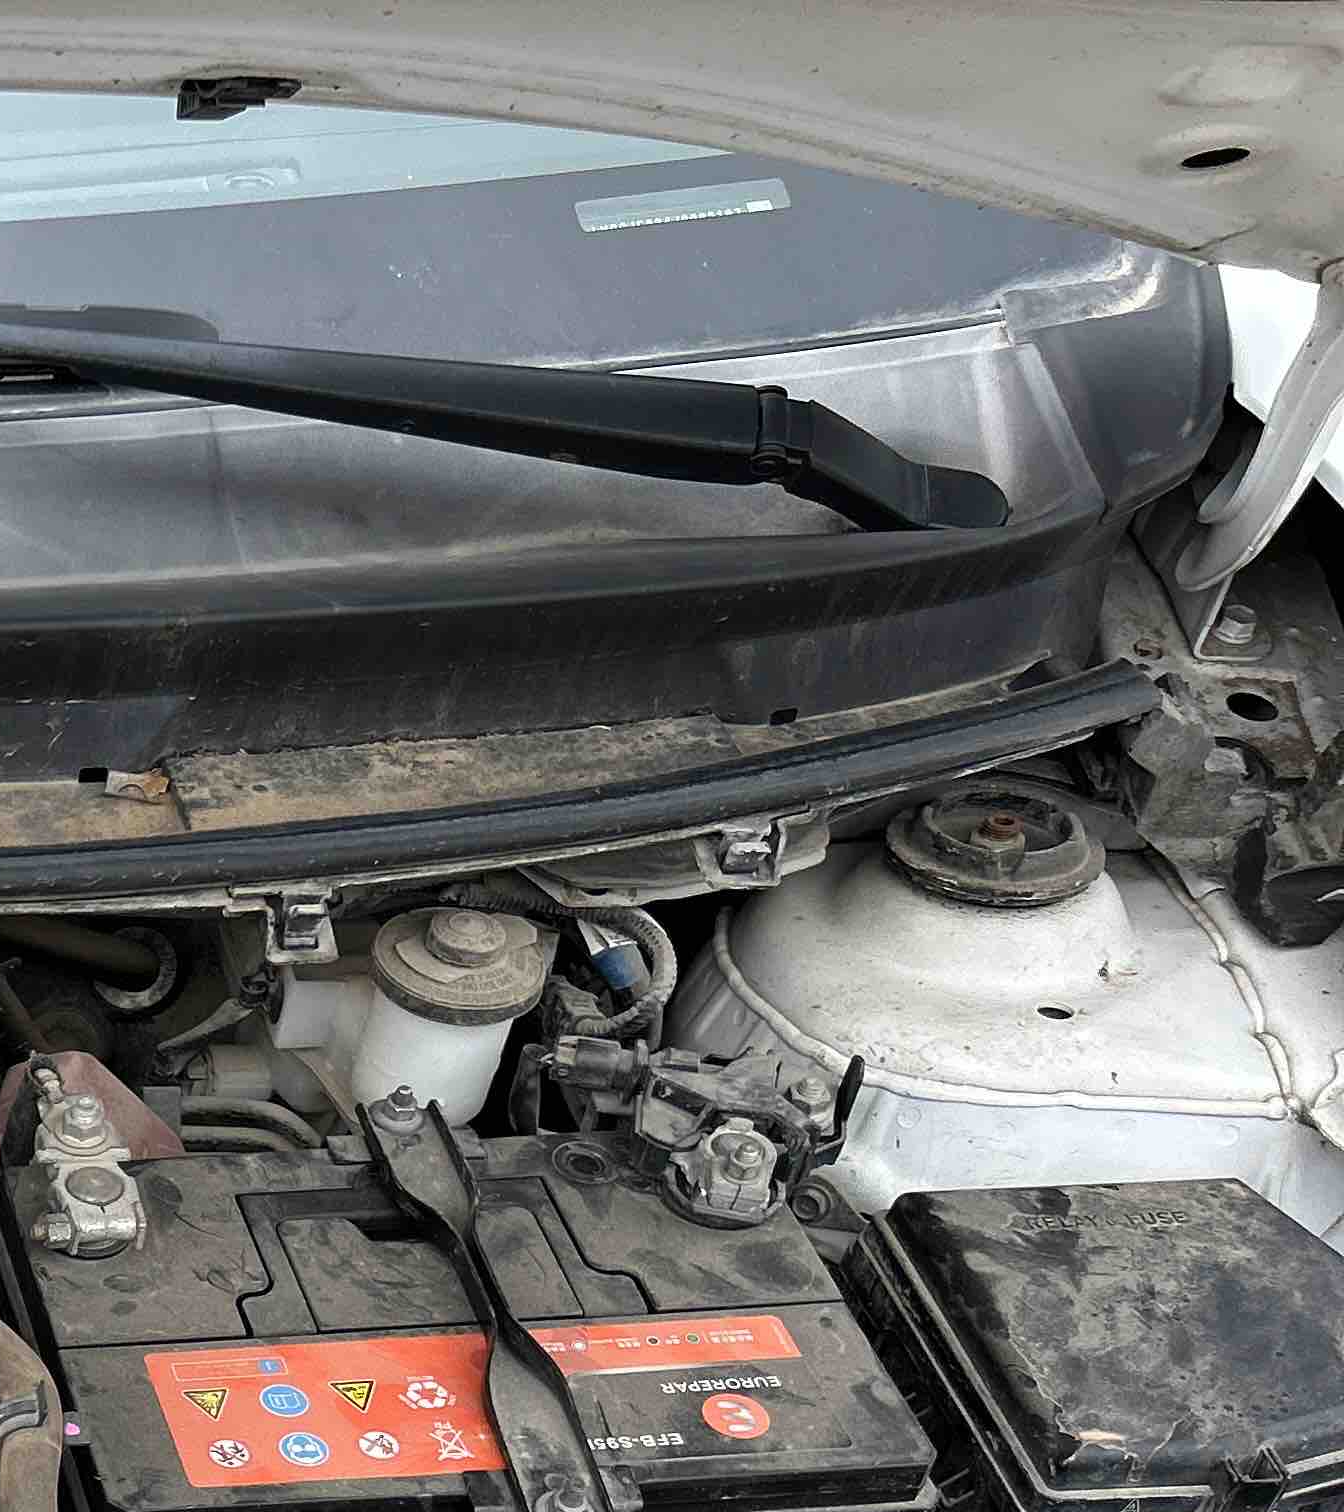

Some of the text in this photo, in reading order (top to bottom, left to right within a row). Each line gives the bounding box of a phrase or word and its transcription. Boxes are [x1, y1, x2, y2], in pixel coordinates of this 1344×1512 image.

[1025, 1213, 1098, 1230] RELAY
[1125, 1210, 1188, 1225] FUSE
[659, 1374, 783, 1394] EUROREPAR
